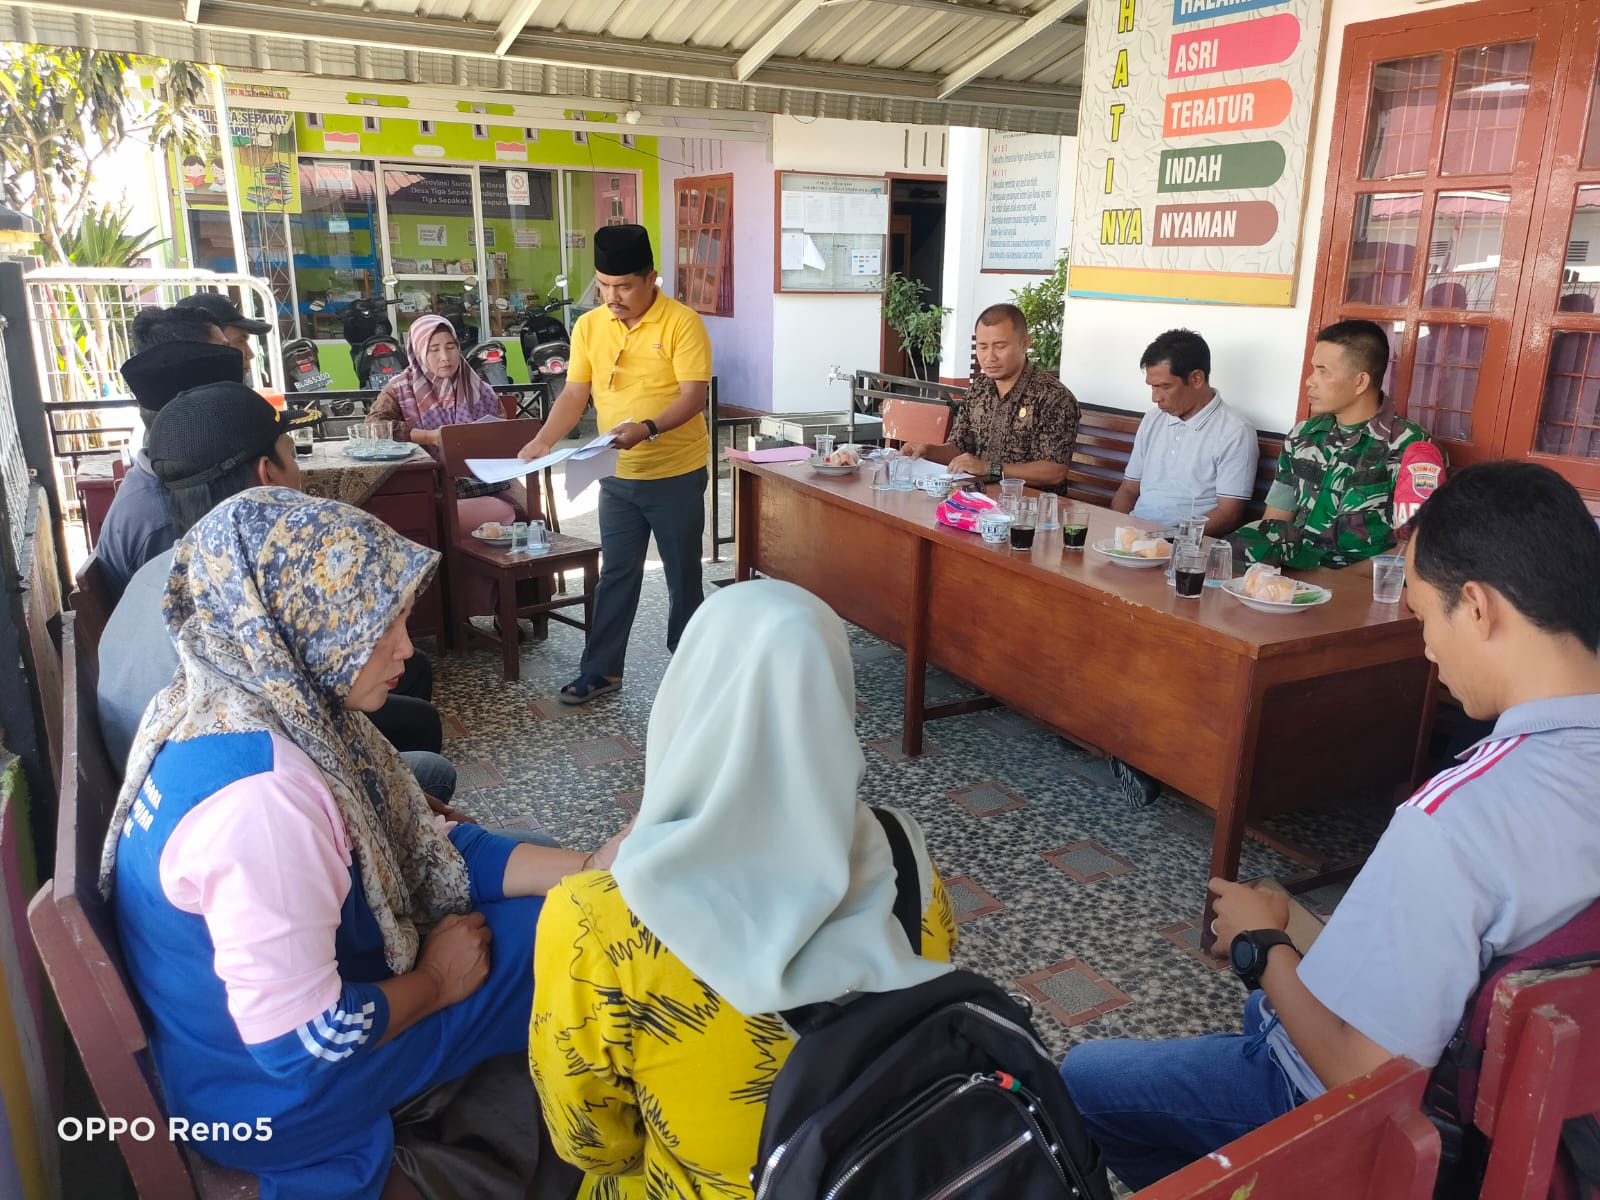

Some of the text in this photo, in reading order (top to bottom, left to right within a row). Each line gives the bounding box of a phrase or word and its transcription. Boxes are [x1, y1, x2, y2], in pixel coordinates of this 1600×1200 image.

[1174, 39, 1219, 74] ASRI
[1171, 93, 1255, 130] TERATUR
[1165, 154, 1223, 185] INDAH
[1100, 208, 1143, 245] NYA
[1159, 210, 1237, 239] NYAMAN
